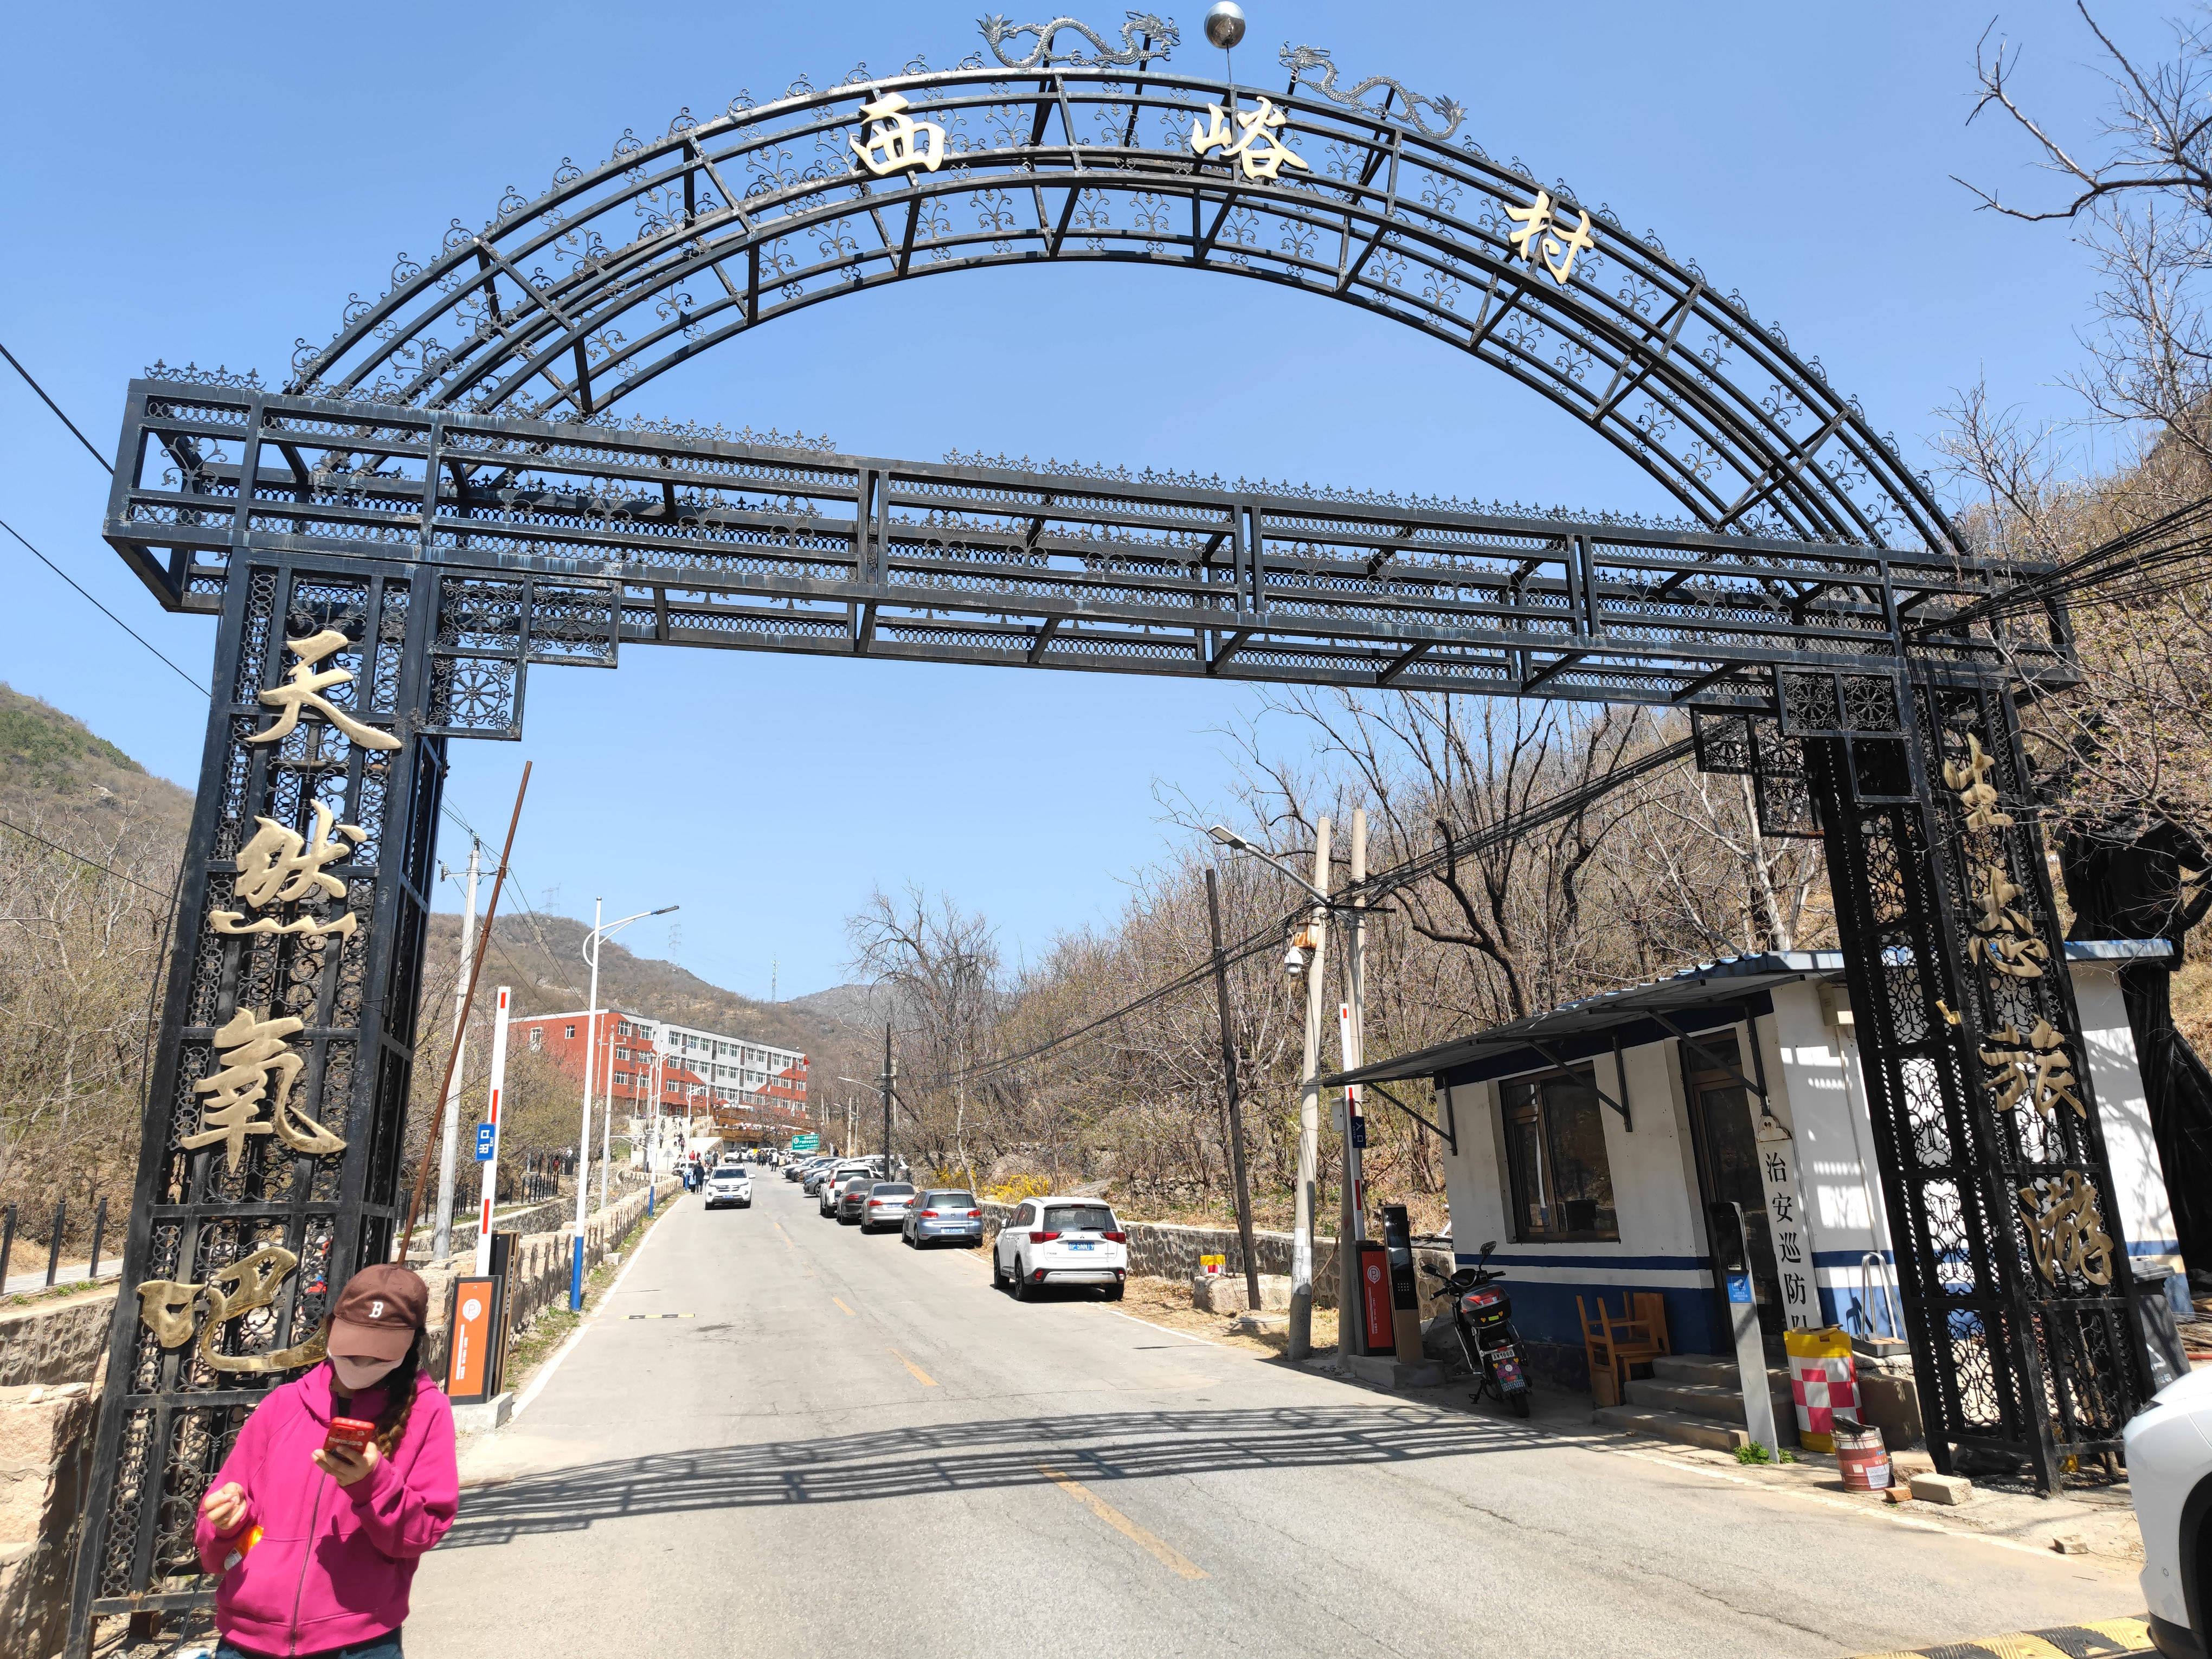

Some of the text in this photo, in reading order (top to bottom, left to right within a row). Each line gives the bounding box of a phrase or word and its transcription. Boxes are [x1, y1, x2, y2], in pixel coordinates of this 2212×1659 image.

[850, 93, 1595, 285] 西峪村
[135, 629, 402, 1372] 天然氧吧
[478, 1130, 490, 1154] 出口
[1355, 1122, 1364, 1142] 入口
[369, 1301, 384, 1318] B
